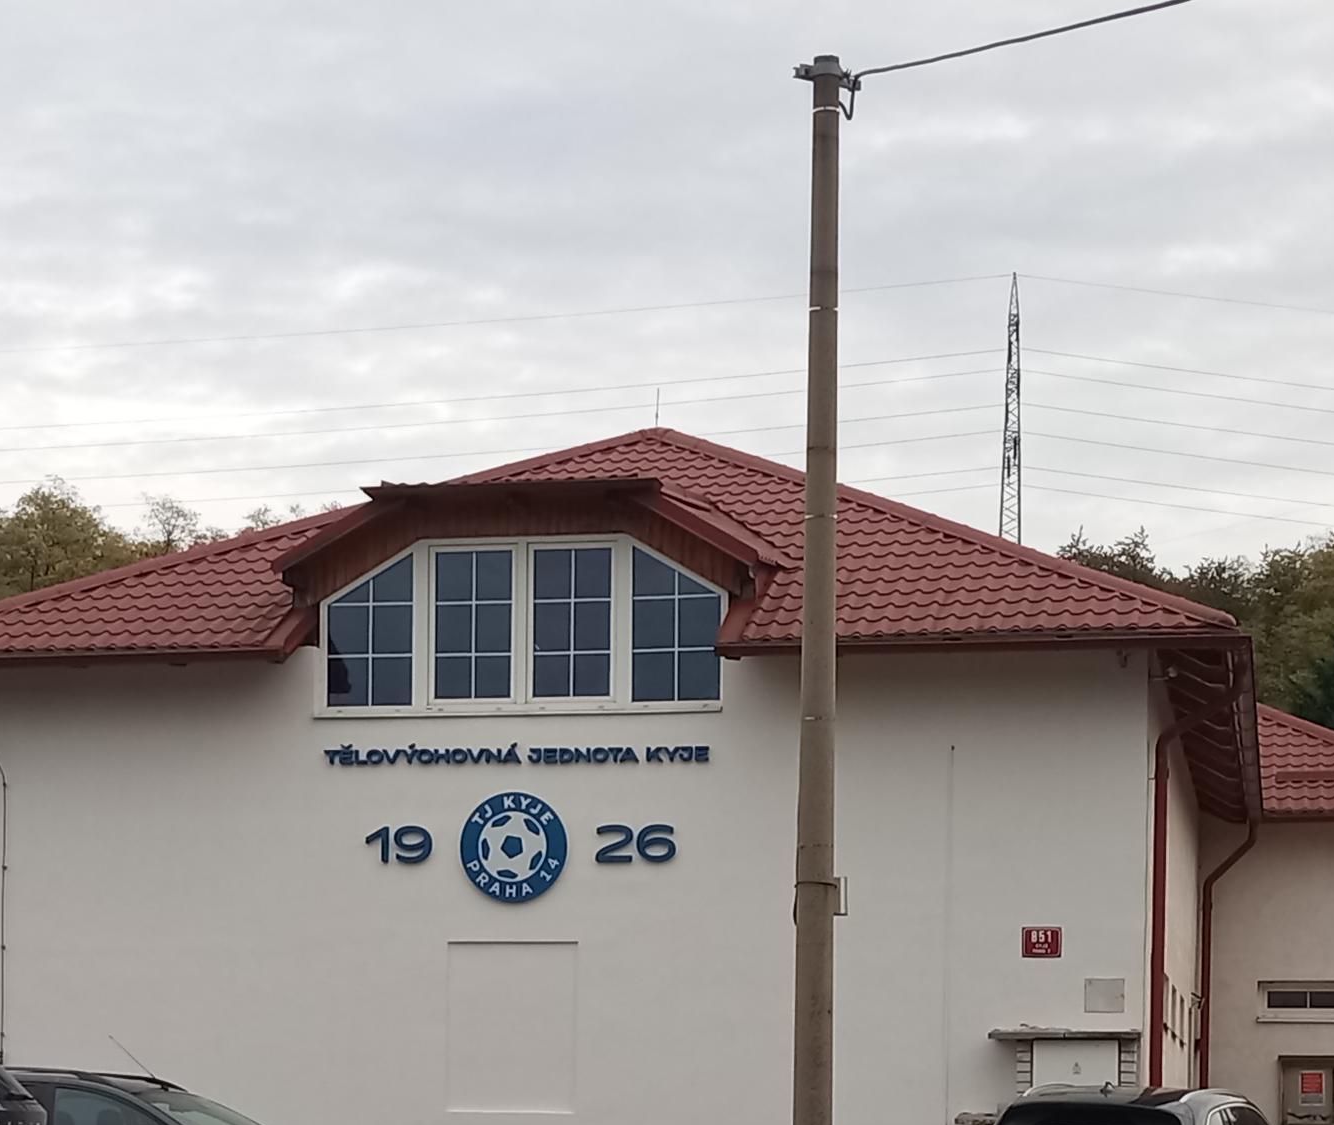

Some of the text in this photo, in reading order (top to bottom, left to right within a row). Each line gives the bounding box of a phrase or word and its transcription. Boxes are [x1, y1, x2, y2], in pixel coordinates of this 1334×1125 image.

[528, 746, 640, 764] JEDNOTA
[645, 746, 710, 763] KYJE
[471, 795, 554, 826] TJ KYJE
[365, 826, 434, 864] 19
[595, 824, 678, 863] 26
[466, 857, 561, 898] PRAHA 14
[1031, 930, 1052, 943] 851
